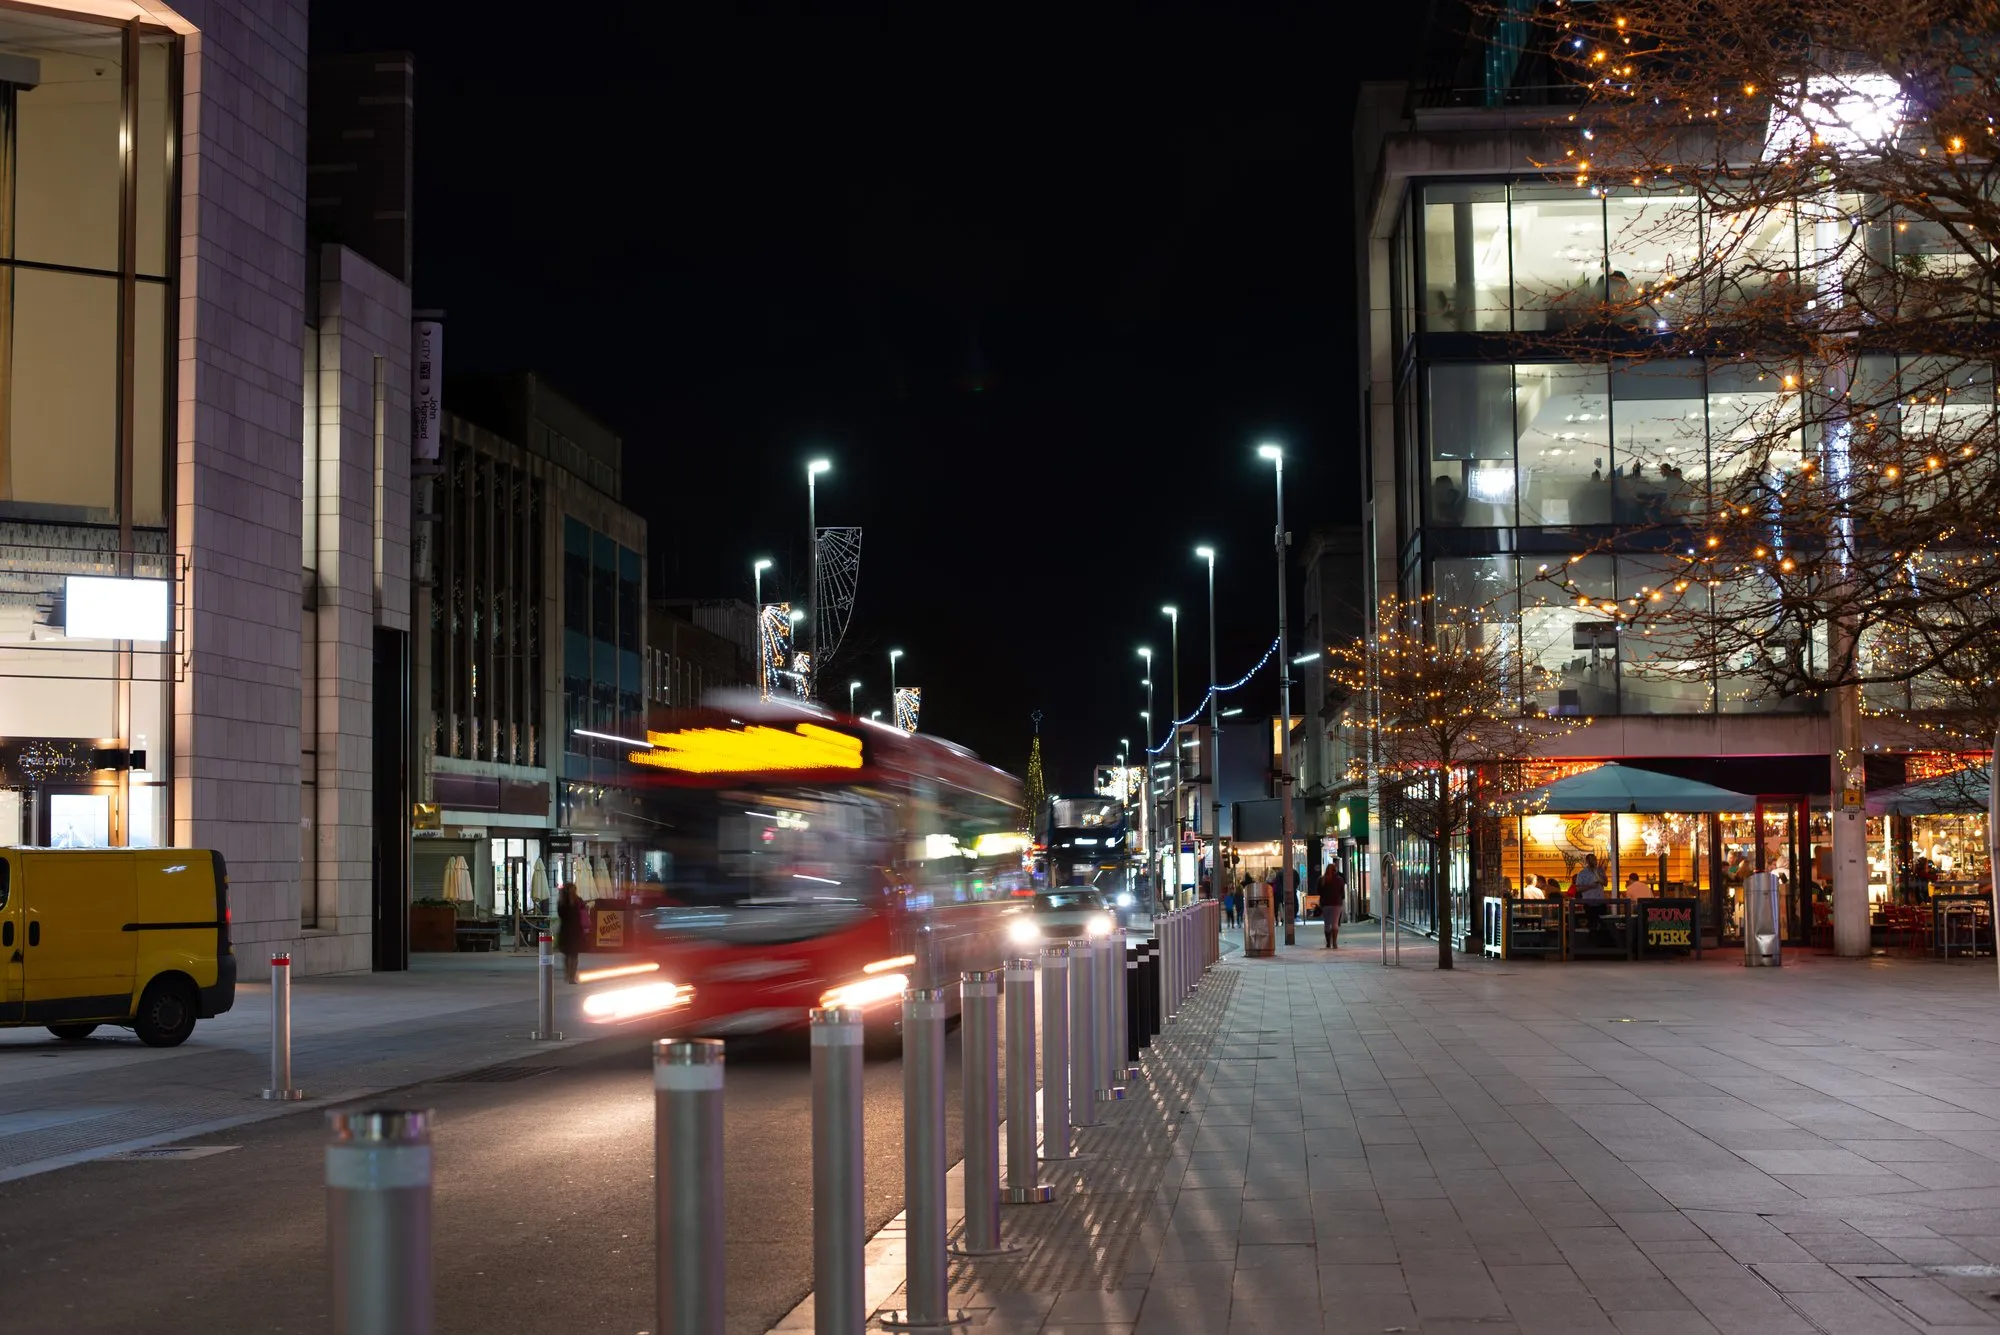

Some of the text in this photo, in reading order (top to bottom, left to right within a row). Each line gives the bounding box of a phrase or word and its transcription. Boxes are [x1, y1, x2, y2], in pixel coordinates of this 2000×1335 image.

[422, 339, 430, 359] CITY
[429, 397, 438, 420] John
[420, 401, 429, 439] Hansard
[18, 754, 76, 768] Free entry
[603, 911, 618, 925] LIVE
[1647, 907, 1692, 922] RUM
[1648, 929, 1692, 946] JERK
